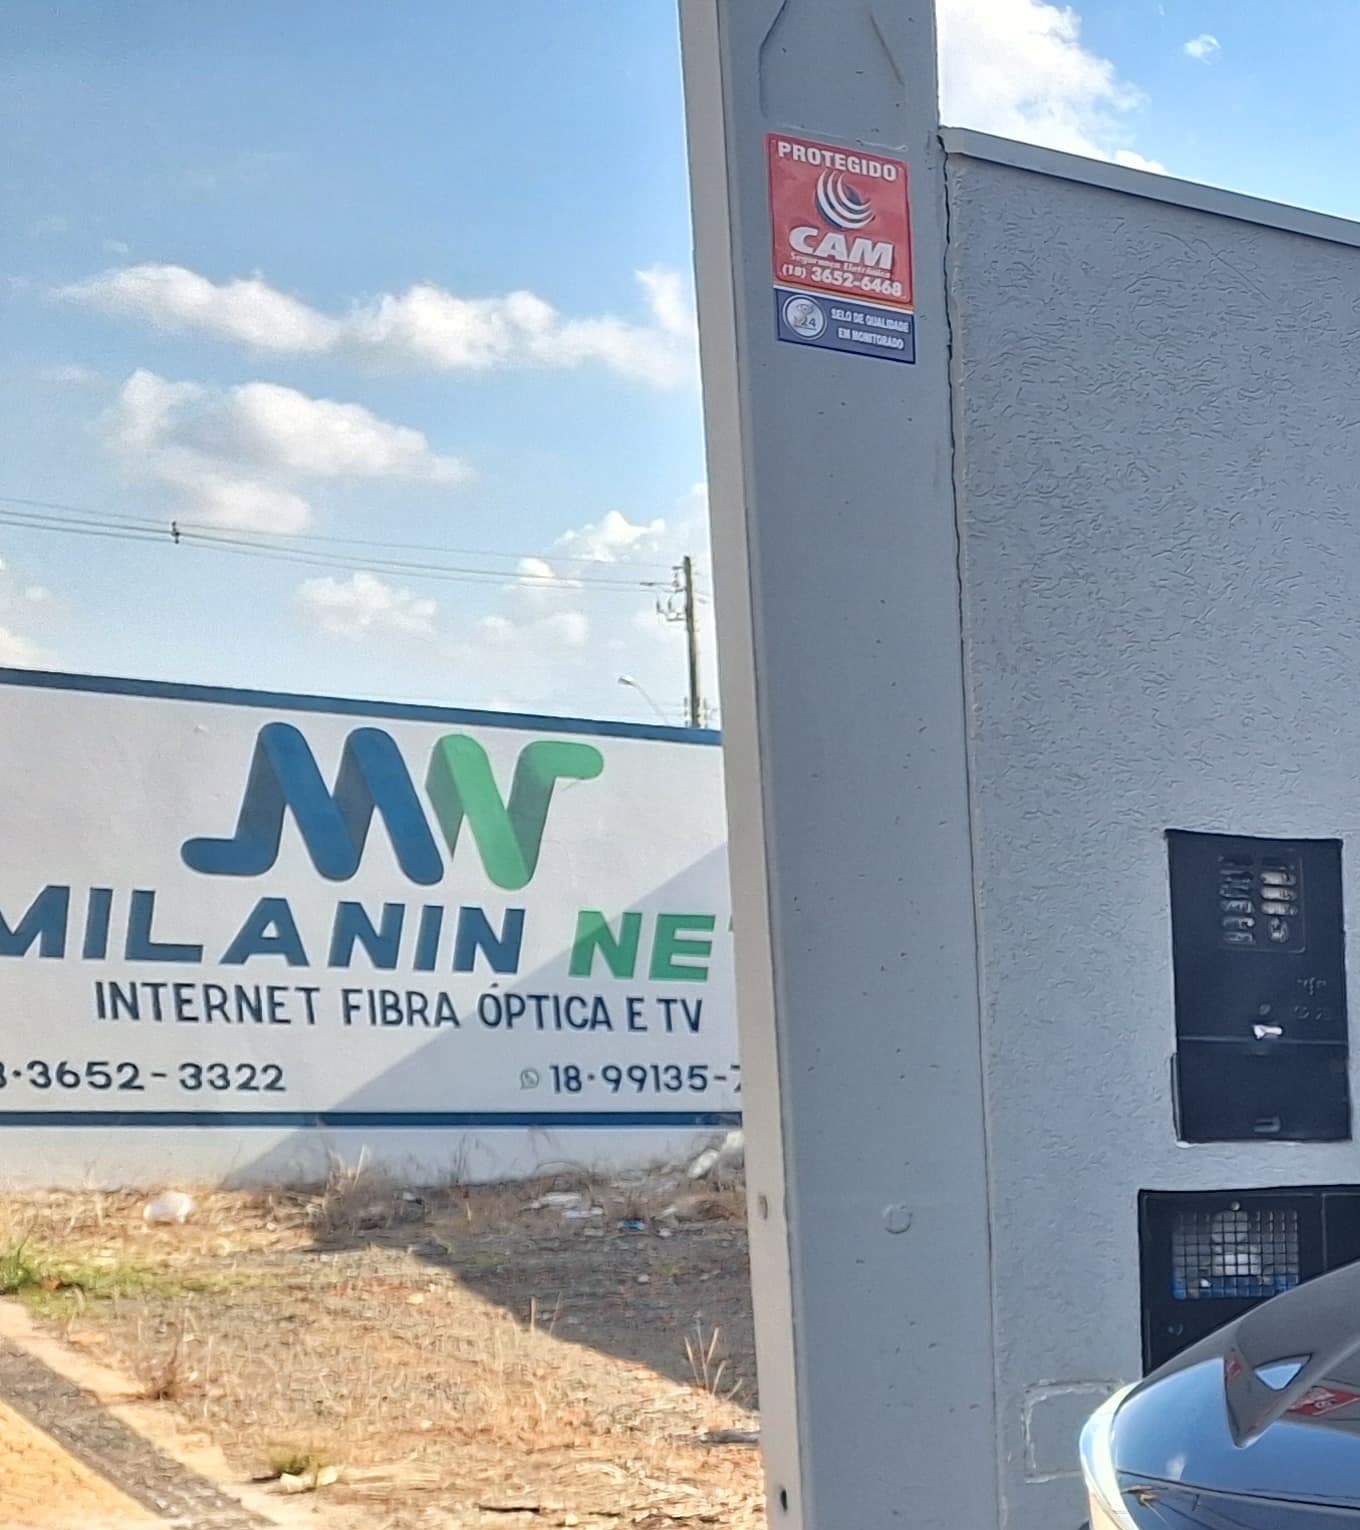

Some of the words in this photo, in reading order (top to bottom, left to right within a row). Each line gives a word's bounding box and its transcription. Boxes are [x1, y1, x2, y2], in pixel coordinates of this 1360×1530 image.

[778, 141, 897, 182] PROTEGIDO
[789, 226, 894, 270] CAM
[811, 266, 902, 297] 3652-6468
[0, 885, 526, 975] MILANIN
[568, 910, 734, 983] NE
[95, 981, 320, 1026] INTERNET
[341, 987, 460, 1028] FIBRA
[477, 982, 613, 1032] ÓPTICA
[626, 996, 648, 1032] E
[656, 997, 703, 1034] TV
